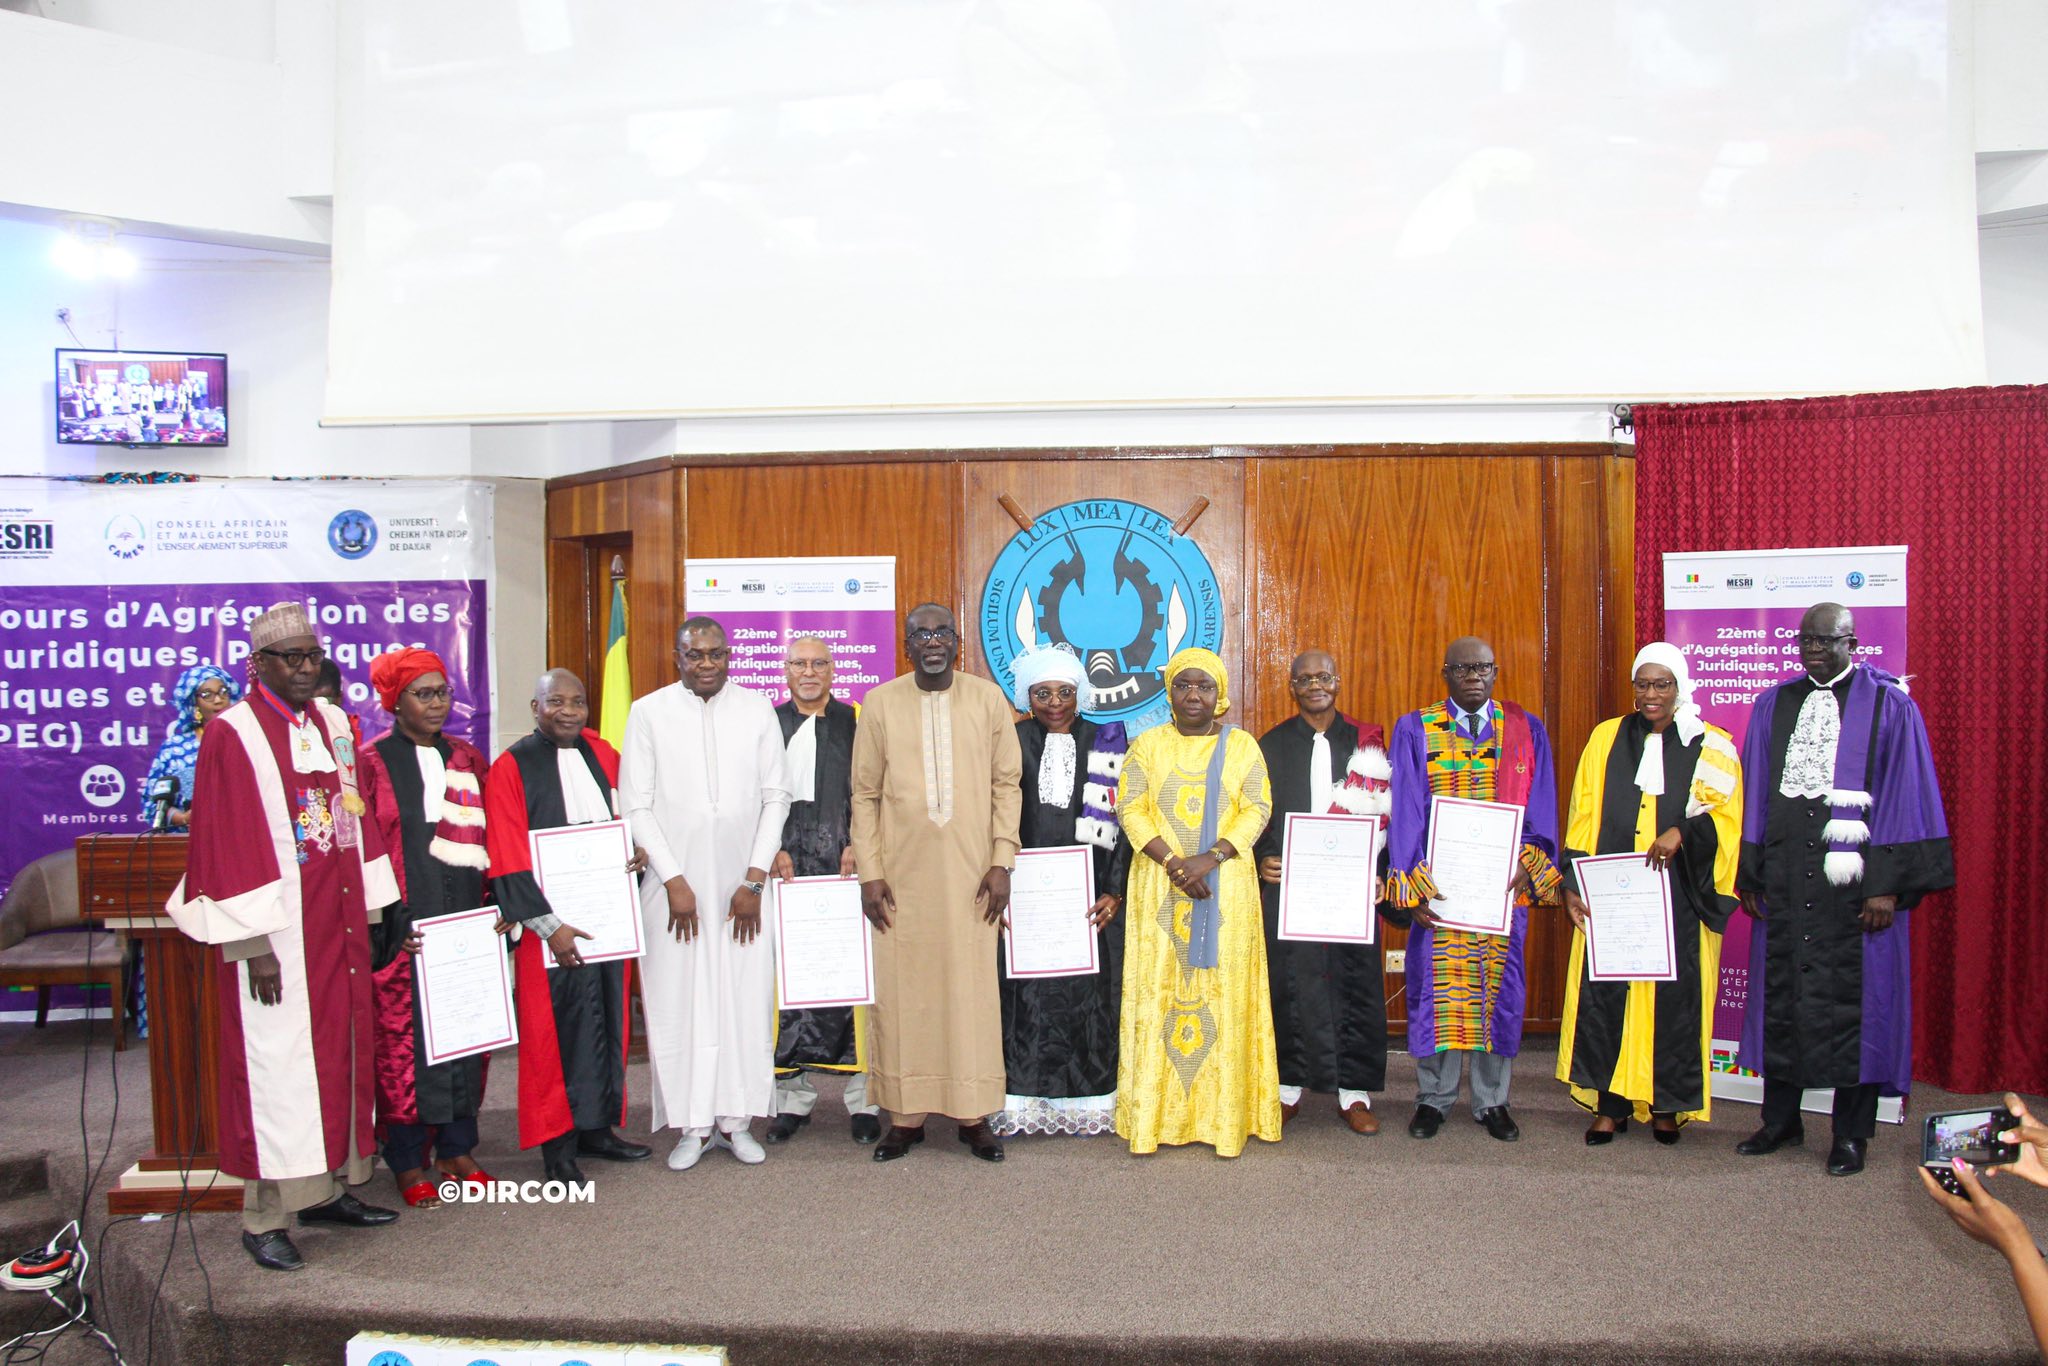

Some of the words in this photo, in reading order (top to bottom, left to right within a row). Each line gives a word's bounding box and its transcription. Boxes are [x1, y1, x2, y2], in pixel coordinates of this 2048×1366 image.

[1073, 502, 1123, 522] MEA
[156, 520, 217, 529] CONSEIL
[224, 519, 288, 528] AFRICAIN
[0, 523, 54, 550] SRI
[156, 531, 172, 540] ET
[179, 530, 249, 539] MALGACHE
[255, 530, 289, 539] POUR
[389, 530, 420, 539] CHEIKH
[1015, 514, 1060, 552] LUX
[108, 543, 145, 560] CAMES
[389, 543, 401, 551] DE
[741, 583, 766, 592] MESRI
[1726, 578, 1753, 587] MESRI
[384, 596, 451, 623] des
[987, 578, 1005, 643] SIGILUM
[733, 627, 778, 639] 22ème
[1716, 627, 1767, 639] 22ème
[1681, 643, 1778, 658] d'Agrégation
[1696, 659, 1779, 674] Juridiques,
[125, 683, 166, 707] et
[100, 720, 148, 746] du
[43, 813, 129, 825] Membres
